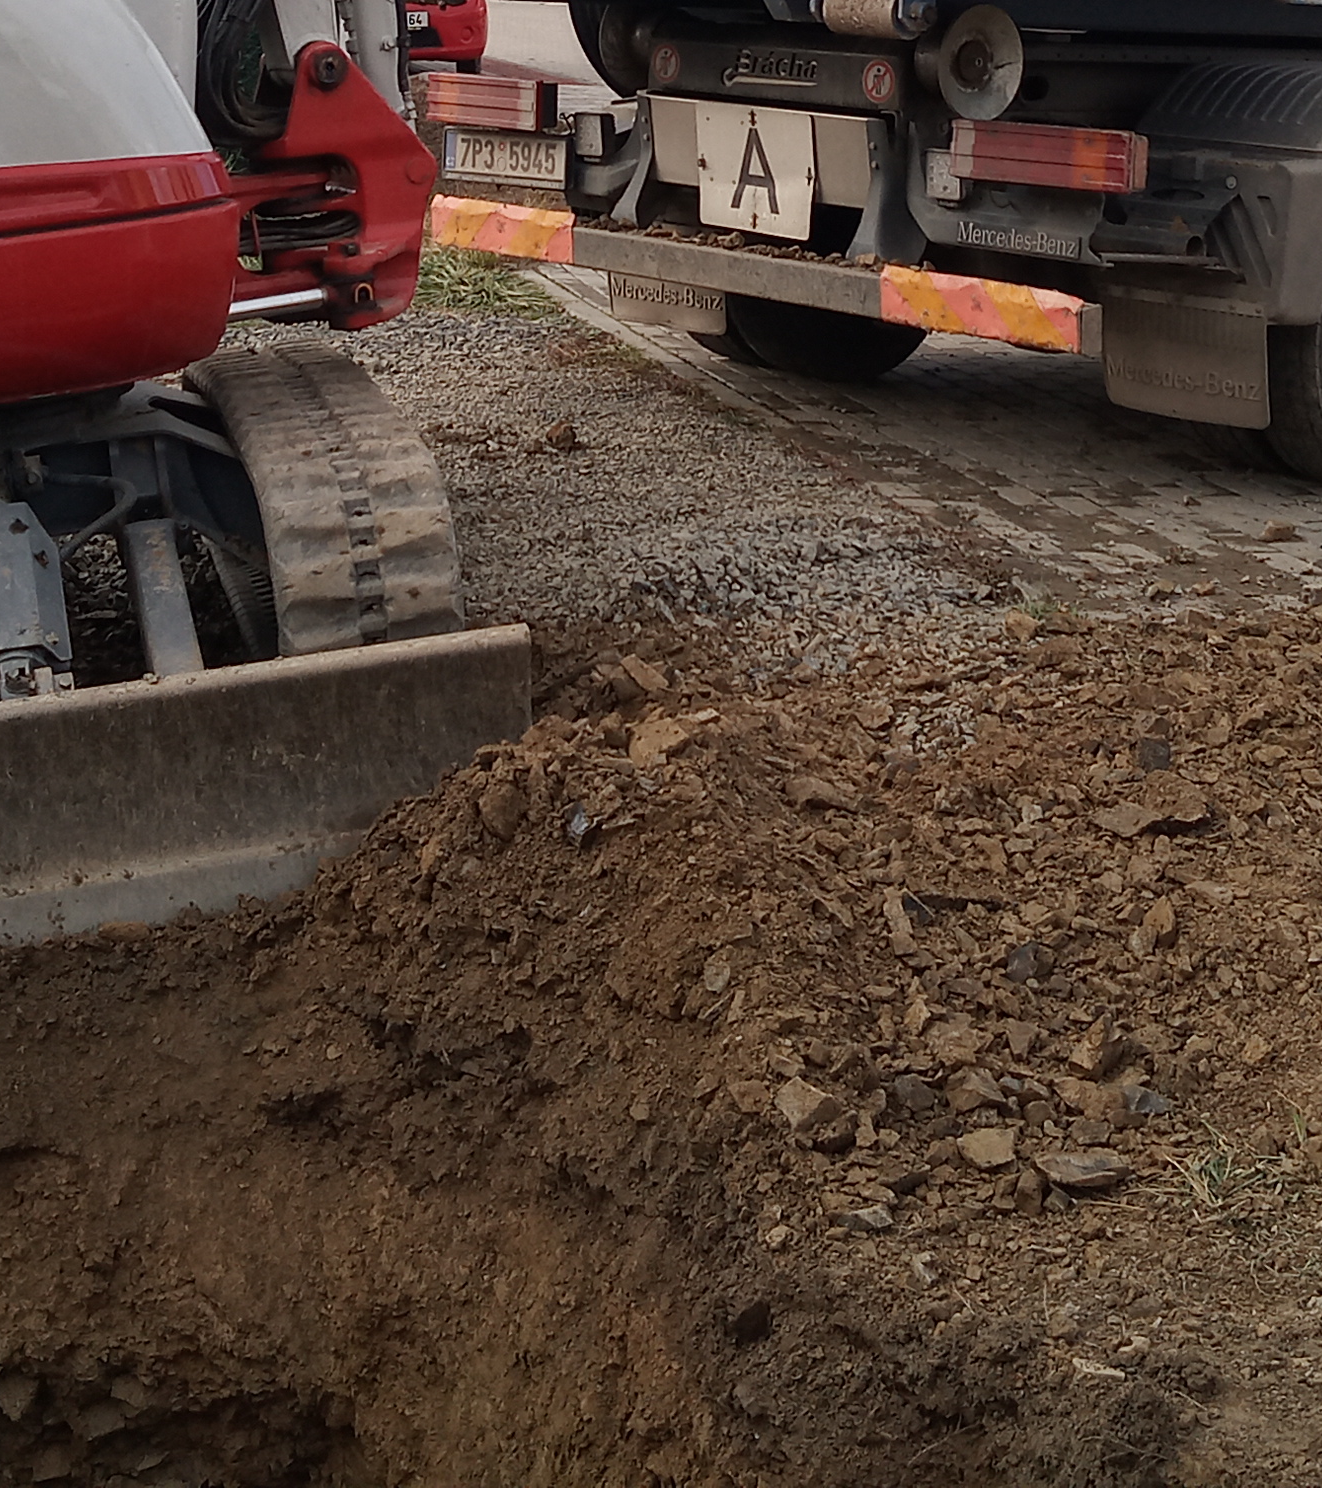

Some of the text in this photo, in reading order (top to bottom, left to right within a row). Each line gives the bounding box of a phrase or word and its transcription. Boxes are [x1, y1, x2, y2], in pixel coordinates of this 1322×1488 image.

[460, 137, 557, 175] 7P3 5945
[730, 127, 780, 215] A
[957, 220, 1076, 258] Mercedes-Benz
[611, 276, 724, 311] Mercedes-Benz
[1105, 352, 1263, 402] Mercedes-Benz
